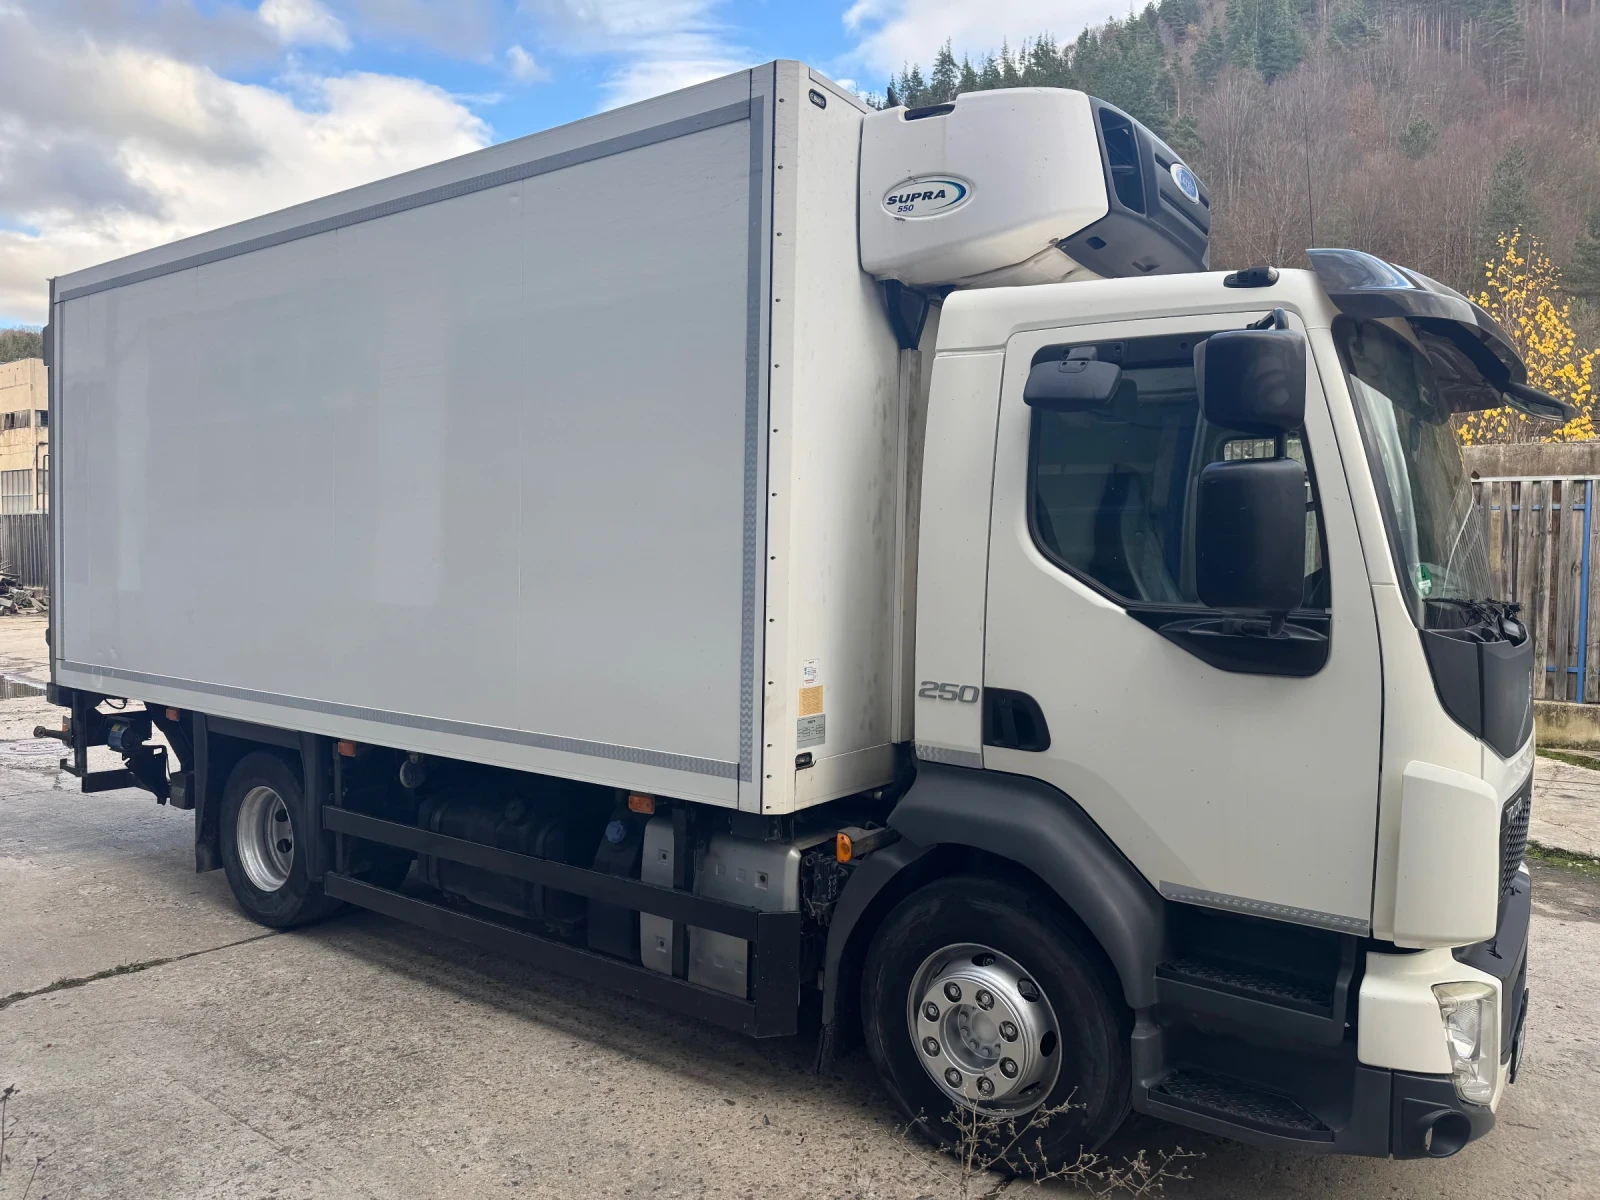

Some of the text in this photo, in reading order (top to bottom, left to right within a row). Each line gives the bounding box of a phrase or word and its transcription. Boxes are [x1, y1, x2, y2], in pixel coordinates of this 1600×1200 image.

[886, 189, 946, 205] SUPRA
[897, 204, 914, 213] 550
[918, 680, 980, 703] 250
